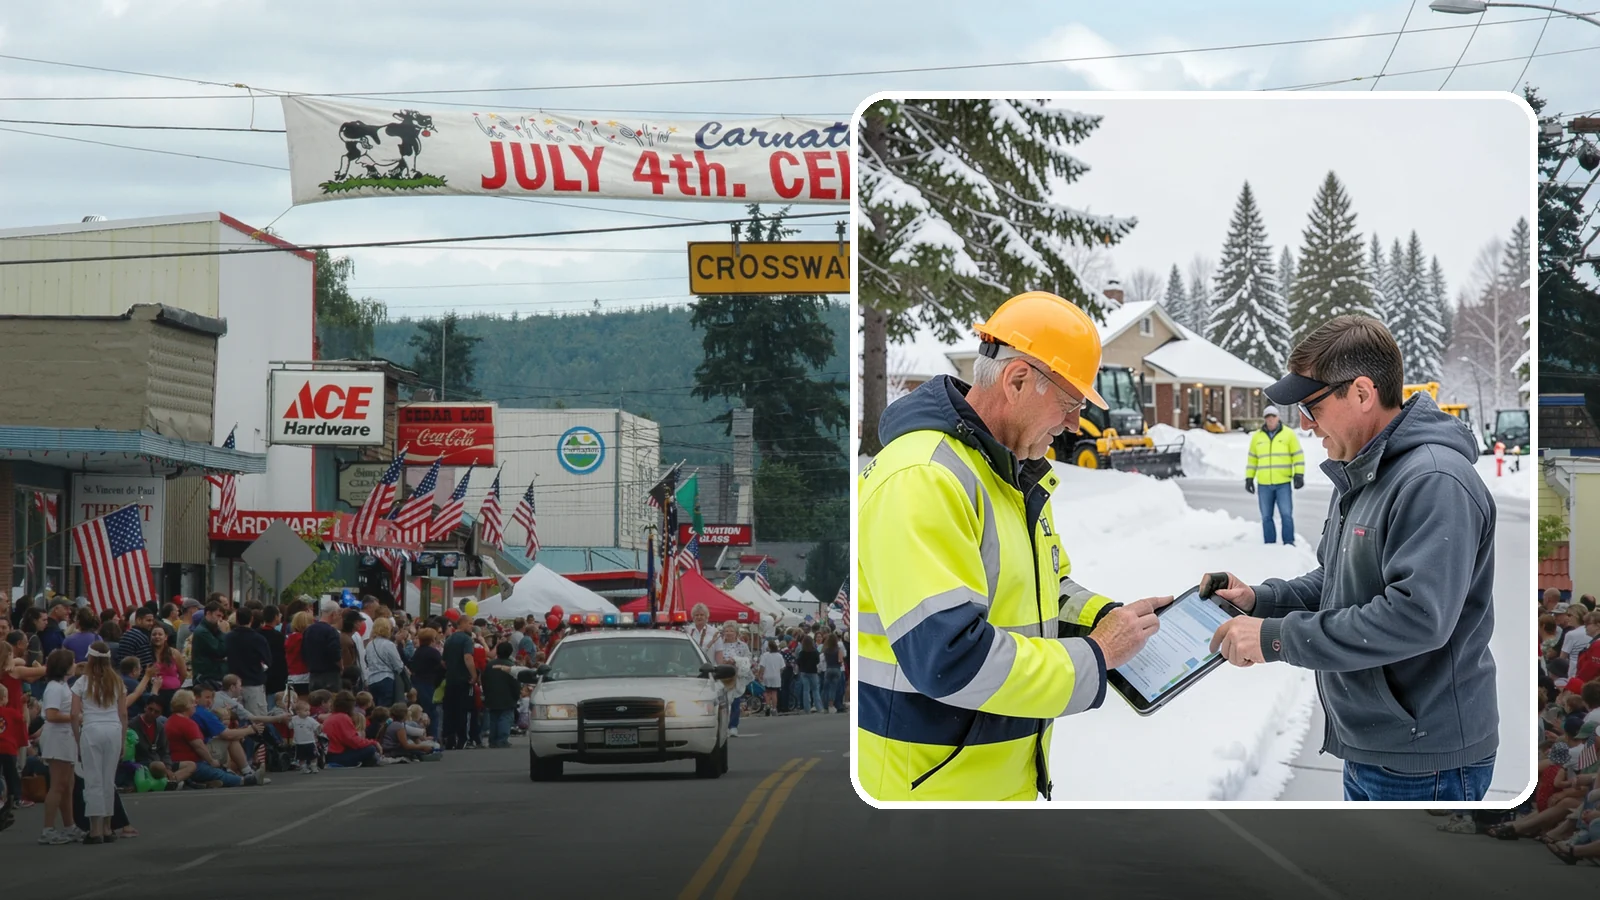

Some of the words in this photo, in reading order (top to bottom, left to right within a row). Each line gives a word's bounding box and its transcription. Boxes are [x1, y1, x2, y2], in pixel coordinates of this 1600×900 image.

[481, 141, 605, 192] JULY
[632, 150, 746, 197] 4th.
[697, 254, 850, 280] CROSSWA
[283, 380, 373, 420] ACE
[405, 409, 453, 422] CEDAR
[461, 409, 485, 422] LOG
[283, 421, 371, 437] Hardware
[416, 428, 477, 447] Coca-Cola
[353, 467, 386, 480] Simpl
[83, 486, 93, 494] St.
[95, 485, 124, 495] Vincent
[126, 486, 136, 495] de
[137, 486, 155, 496] Paul
[688, 526, 741, 536] CRNATION
[699, 535, 731, 543] GLASS
